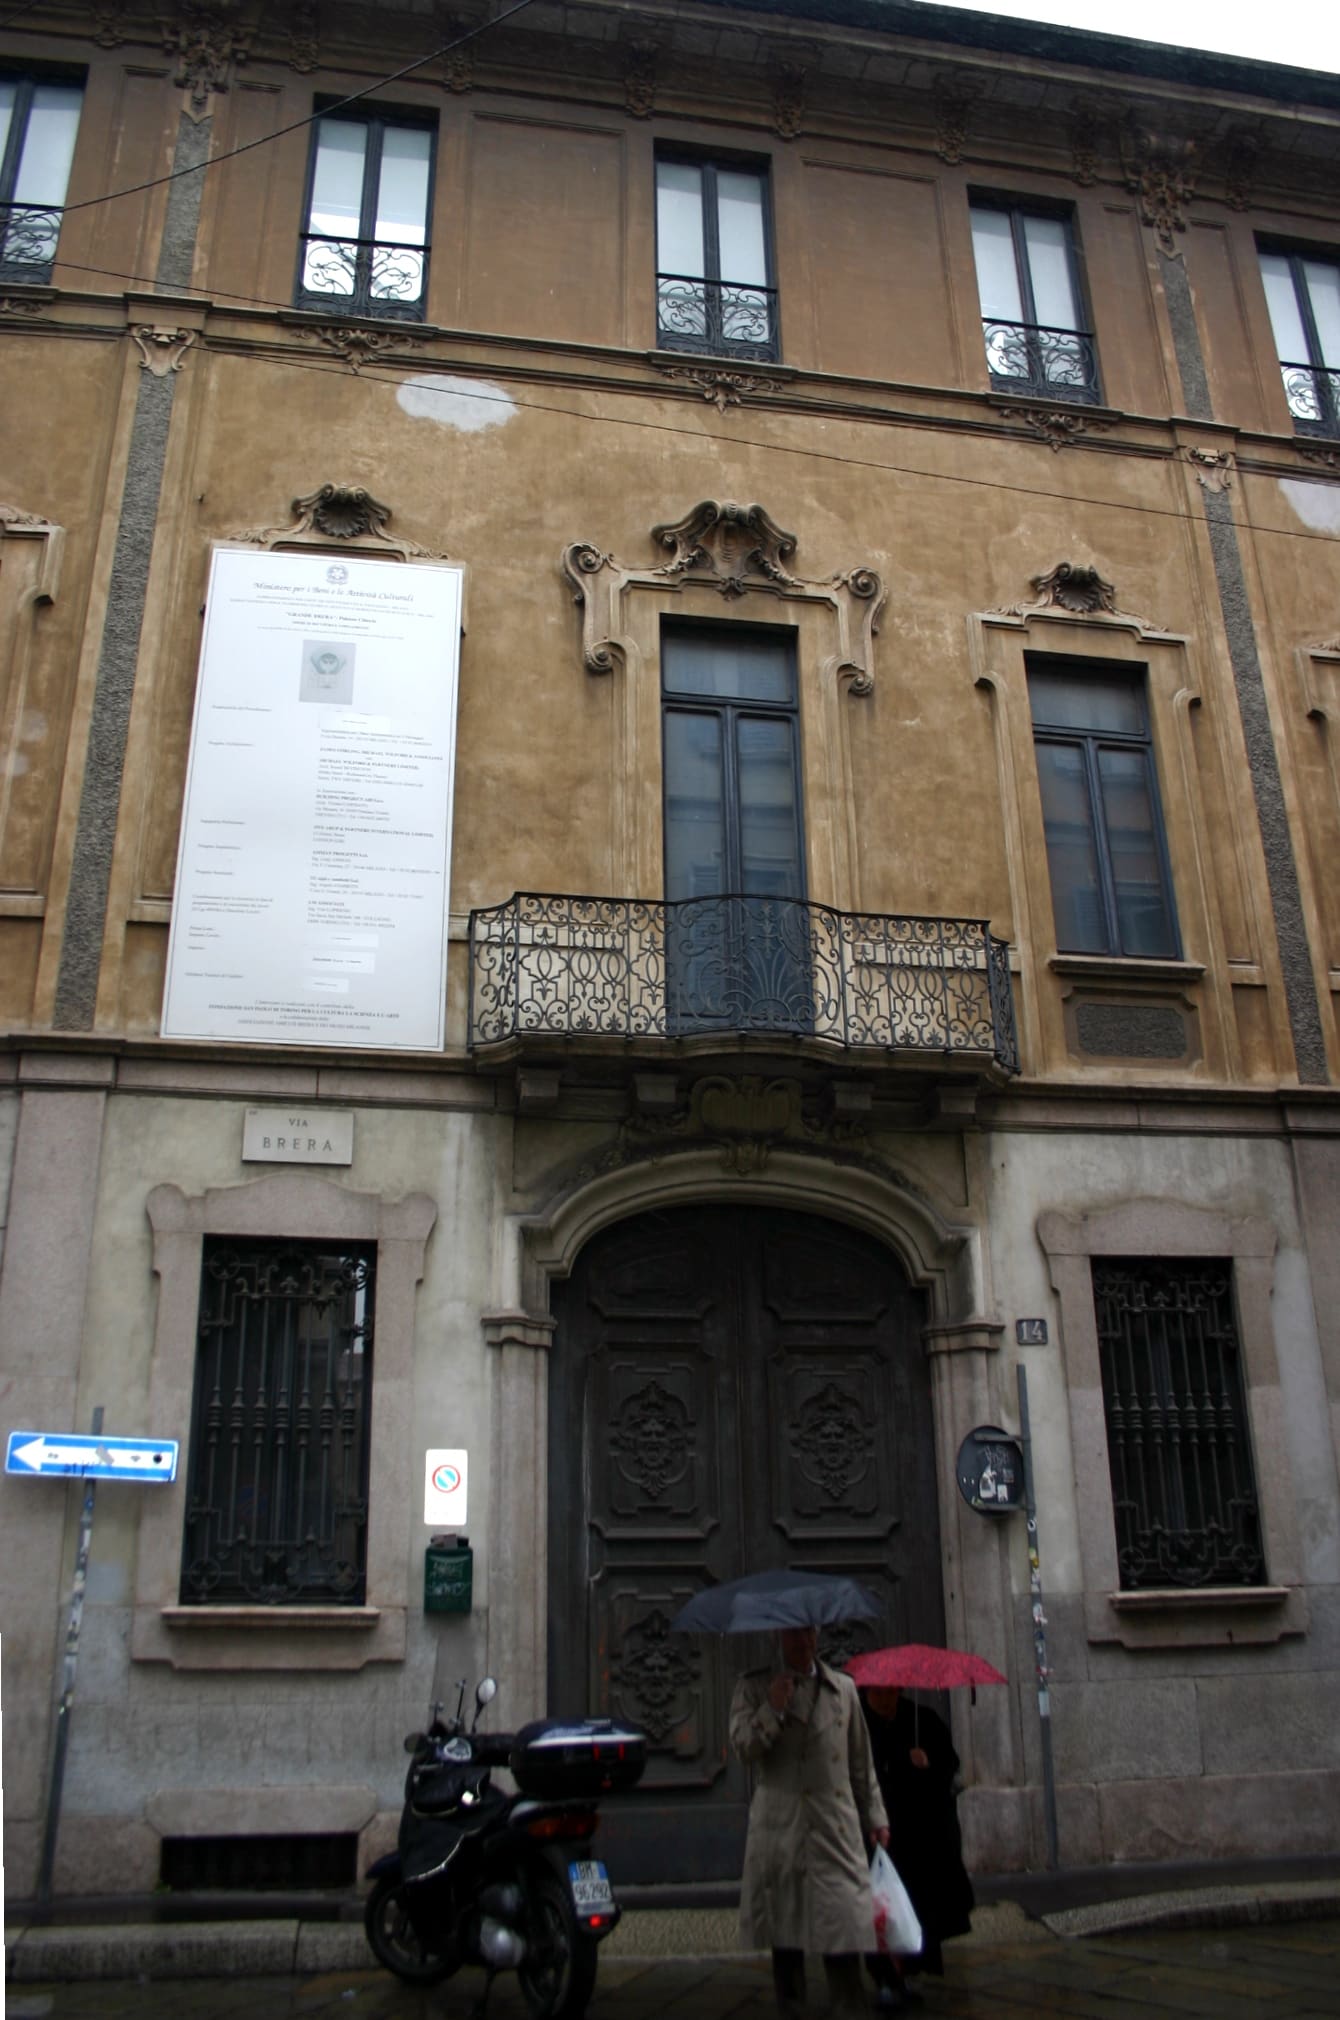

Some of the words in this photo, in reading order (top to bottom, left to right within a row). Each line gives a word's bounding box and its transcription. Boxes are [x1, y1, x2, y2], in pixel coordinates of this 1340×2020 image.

[288, 1118, 308, 1128] VIA
[263, 1136, 332, 1151] BRERA
[1021, 1320, 1043, 1340] 14
